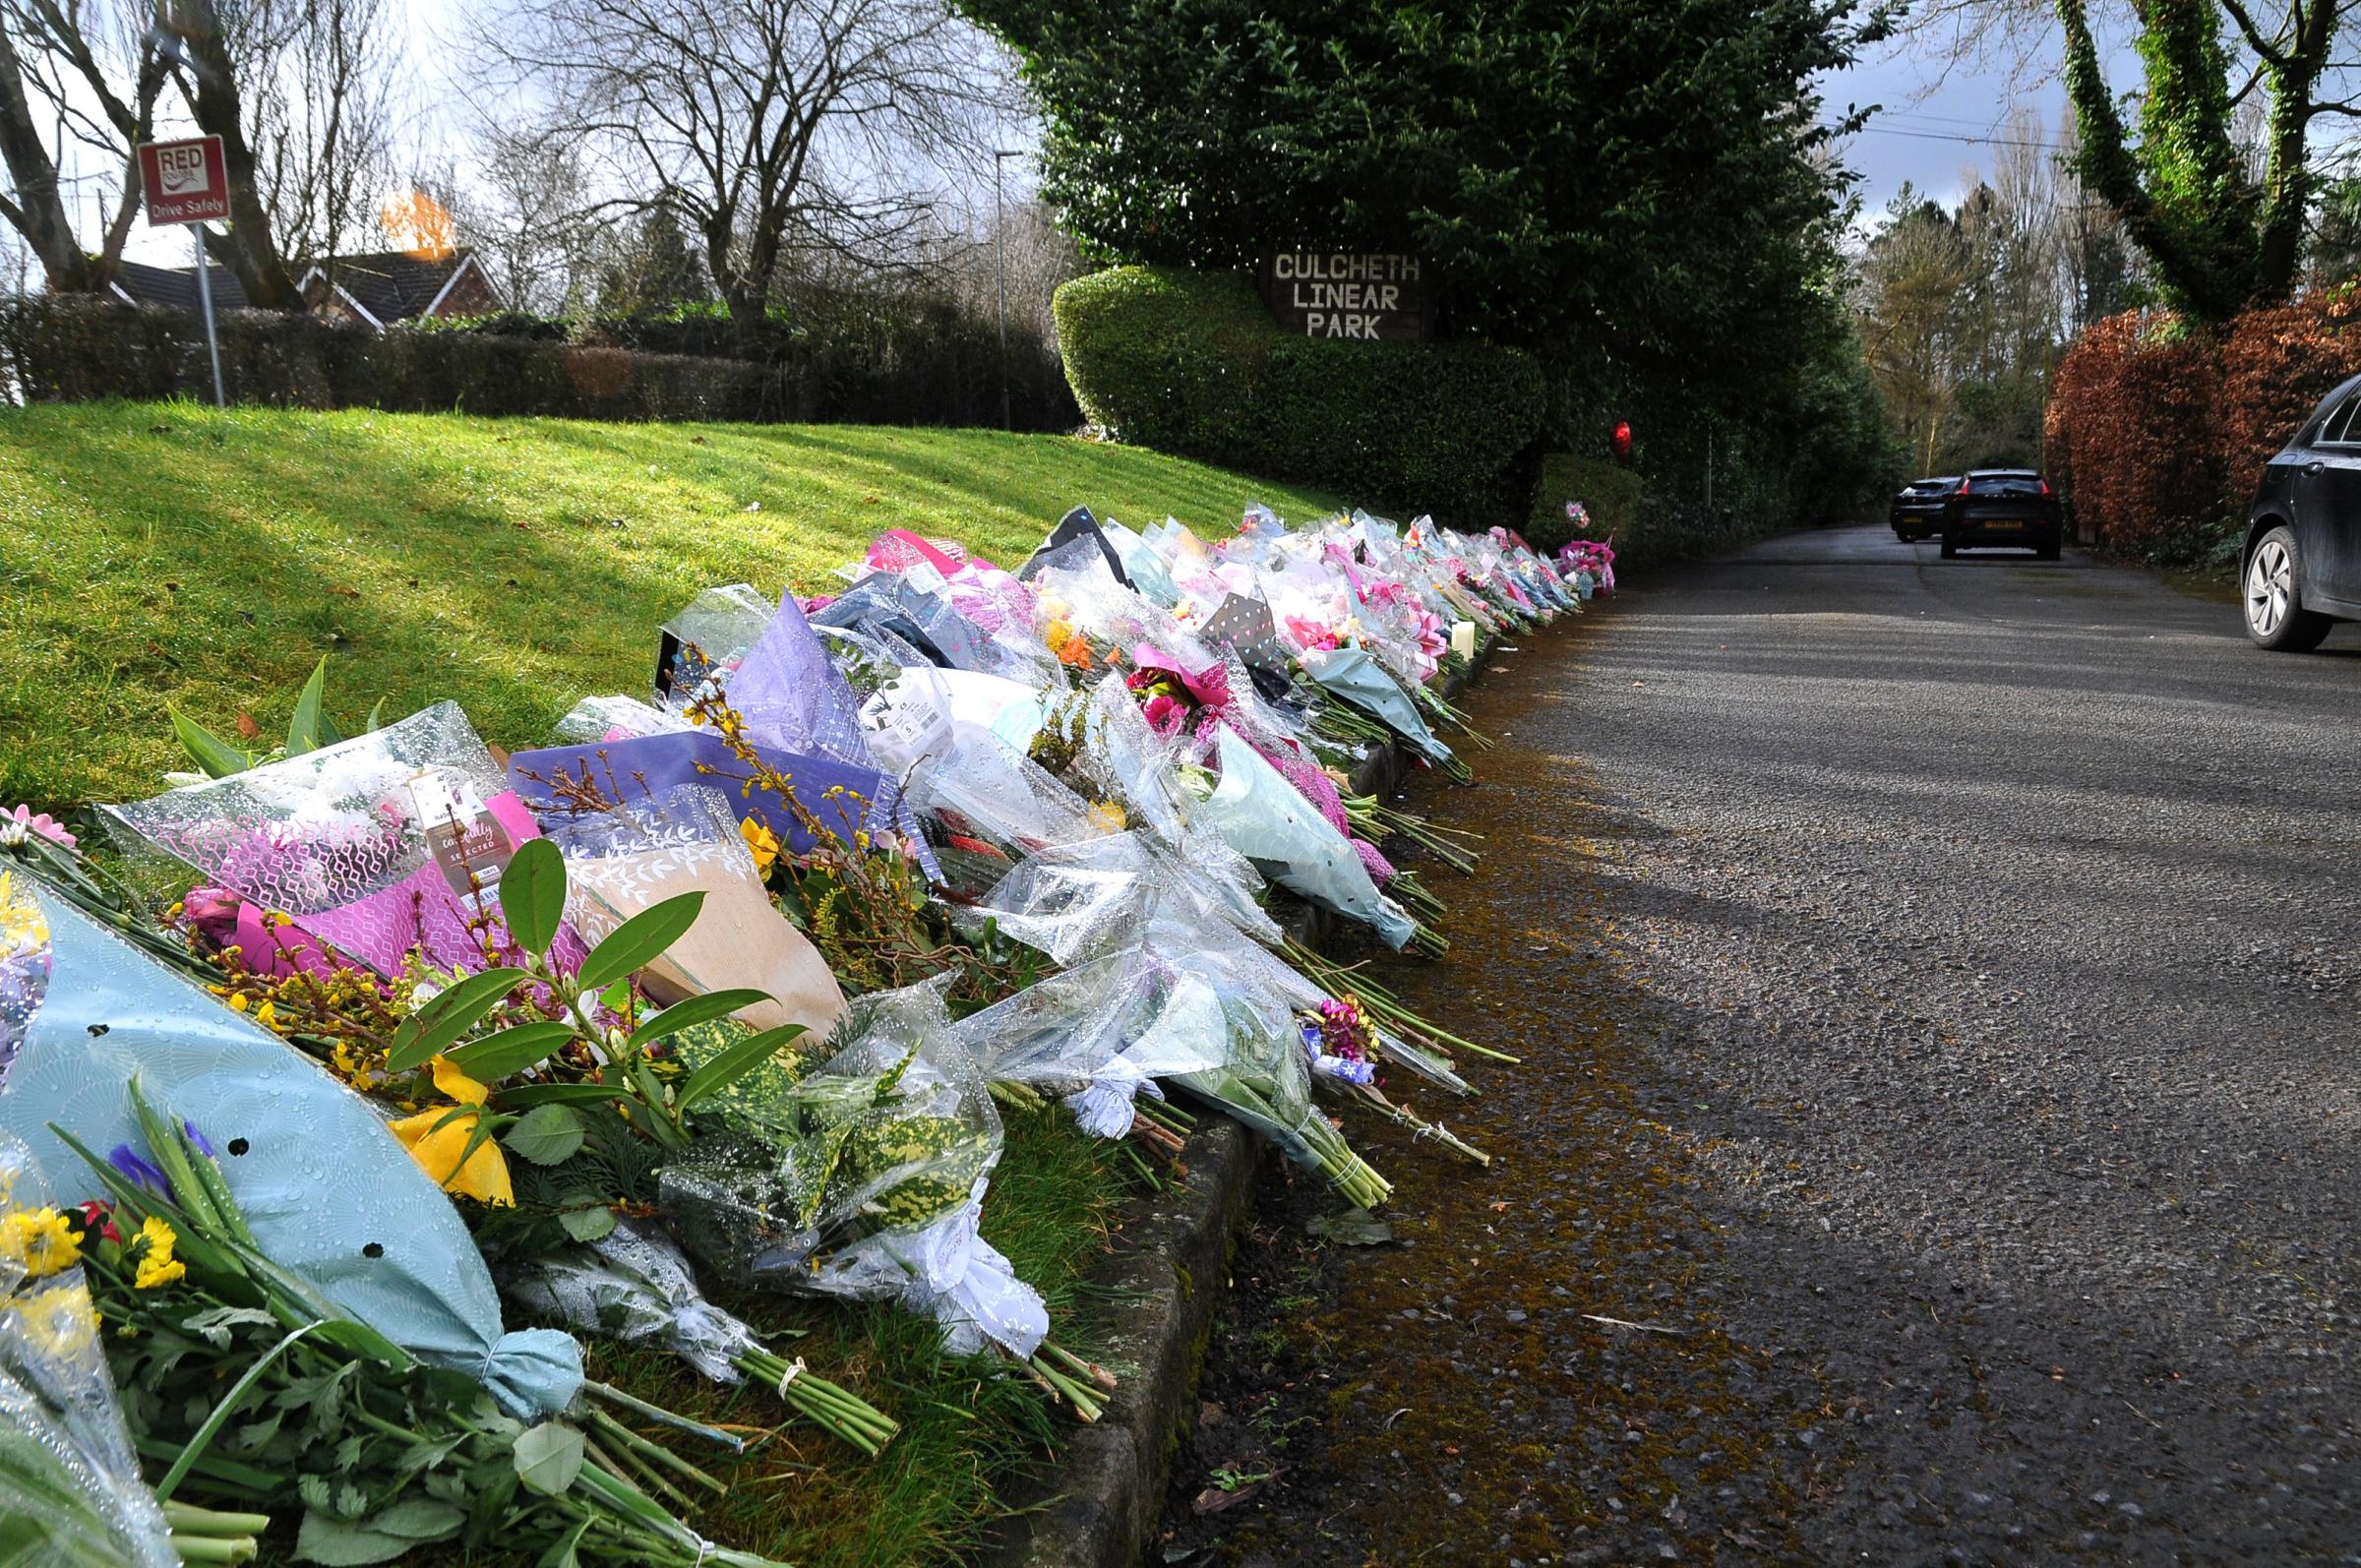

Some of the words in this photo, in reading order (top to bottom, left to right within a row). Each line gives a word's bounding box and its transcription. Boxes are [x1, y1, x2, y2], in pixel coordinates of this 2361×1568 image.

[159, 148, 203, 171] RED
[151, 203, 184, 217] Drive
[185, 198, 224, 214] Safely
[1275, 253, 1421, 281] CULCHETH
[1293, 282, 1400, 311] LINEAR
[1306, 312, 1382, 340] PARK
[450, 841, 495, 862] SEECTED
